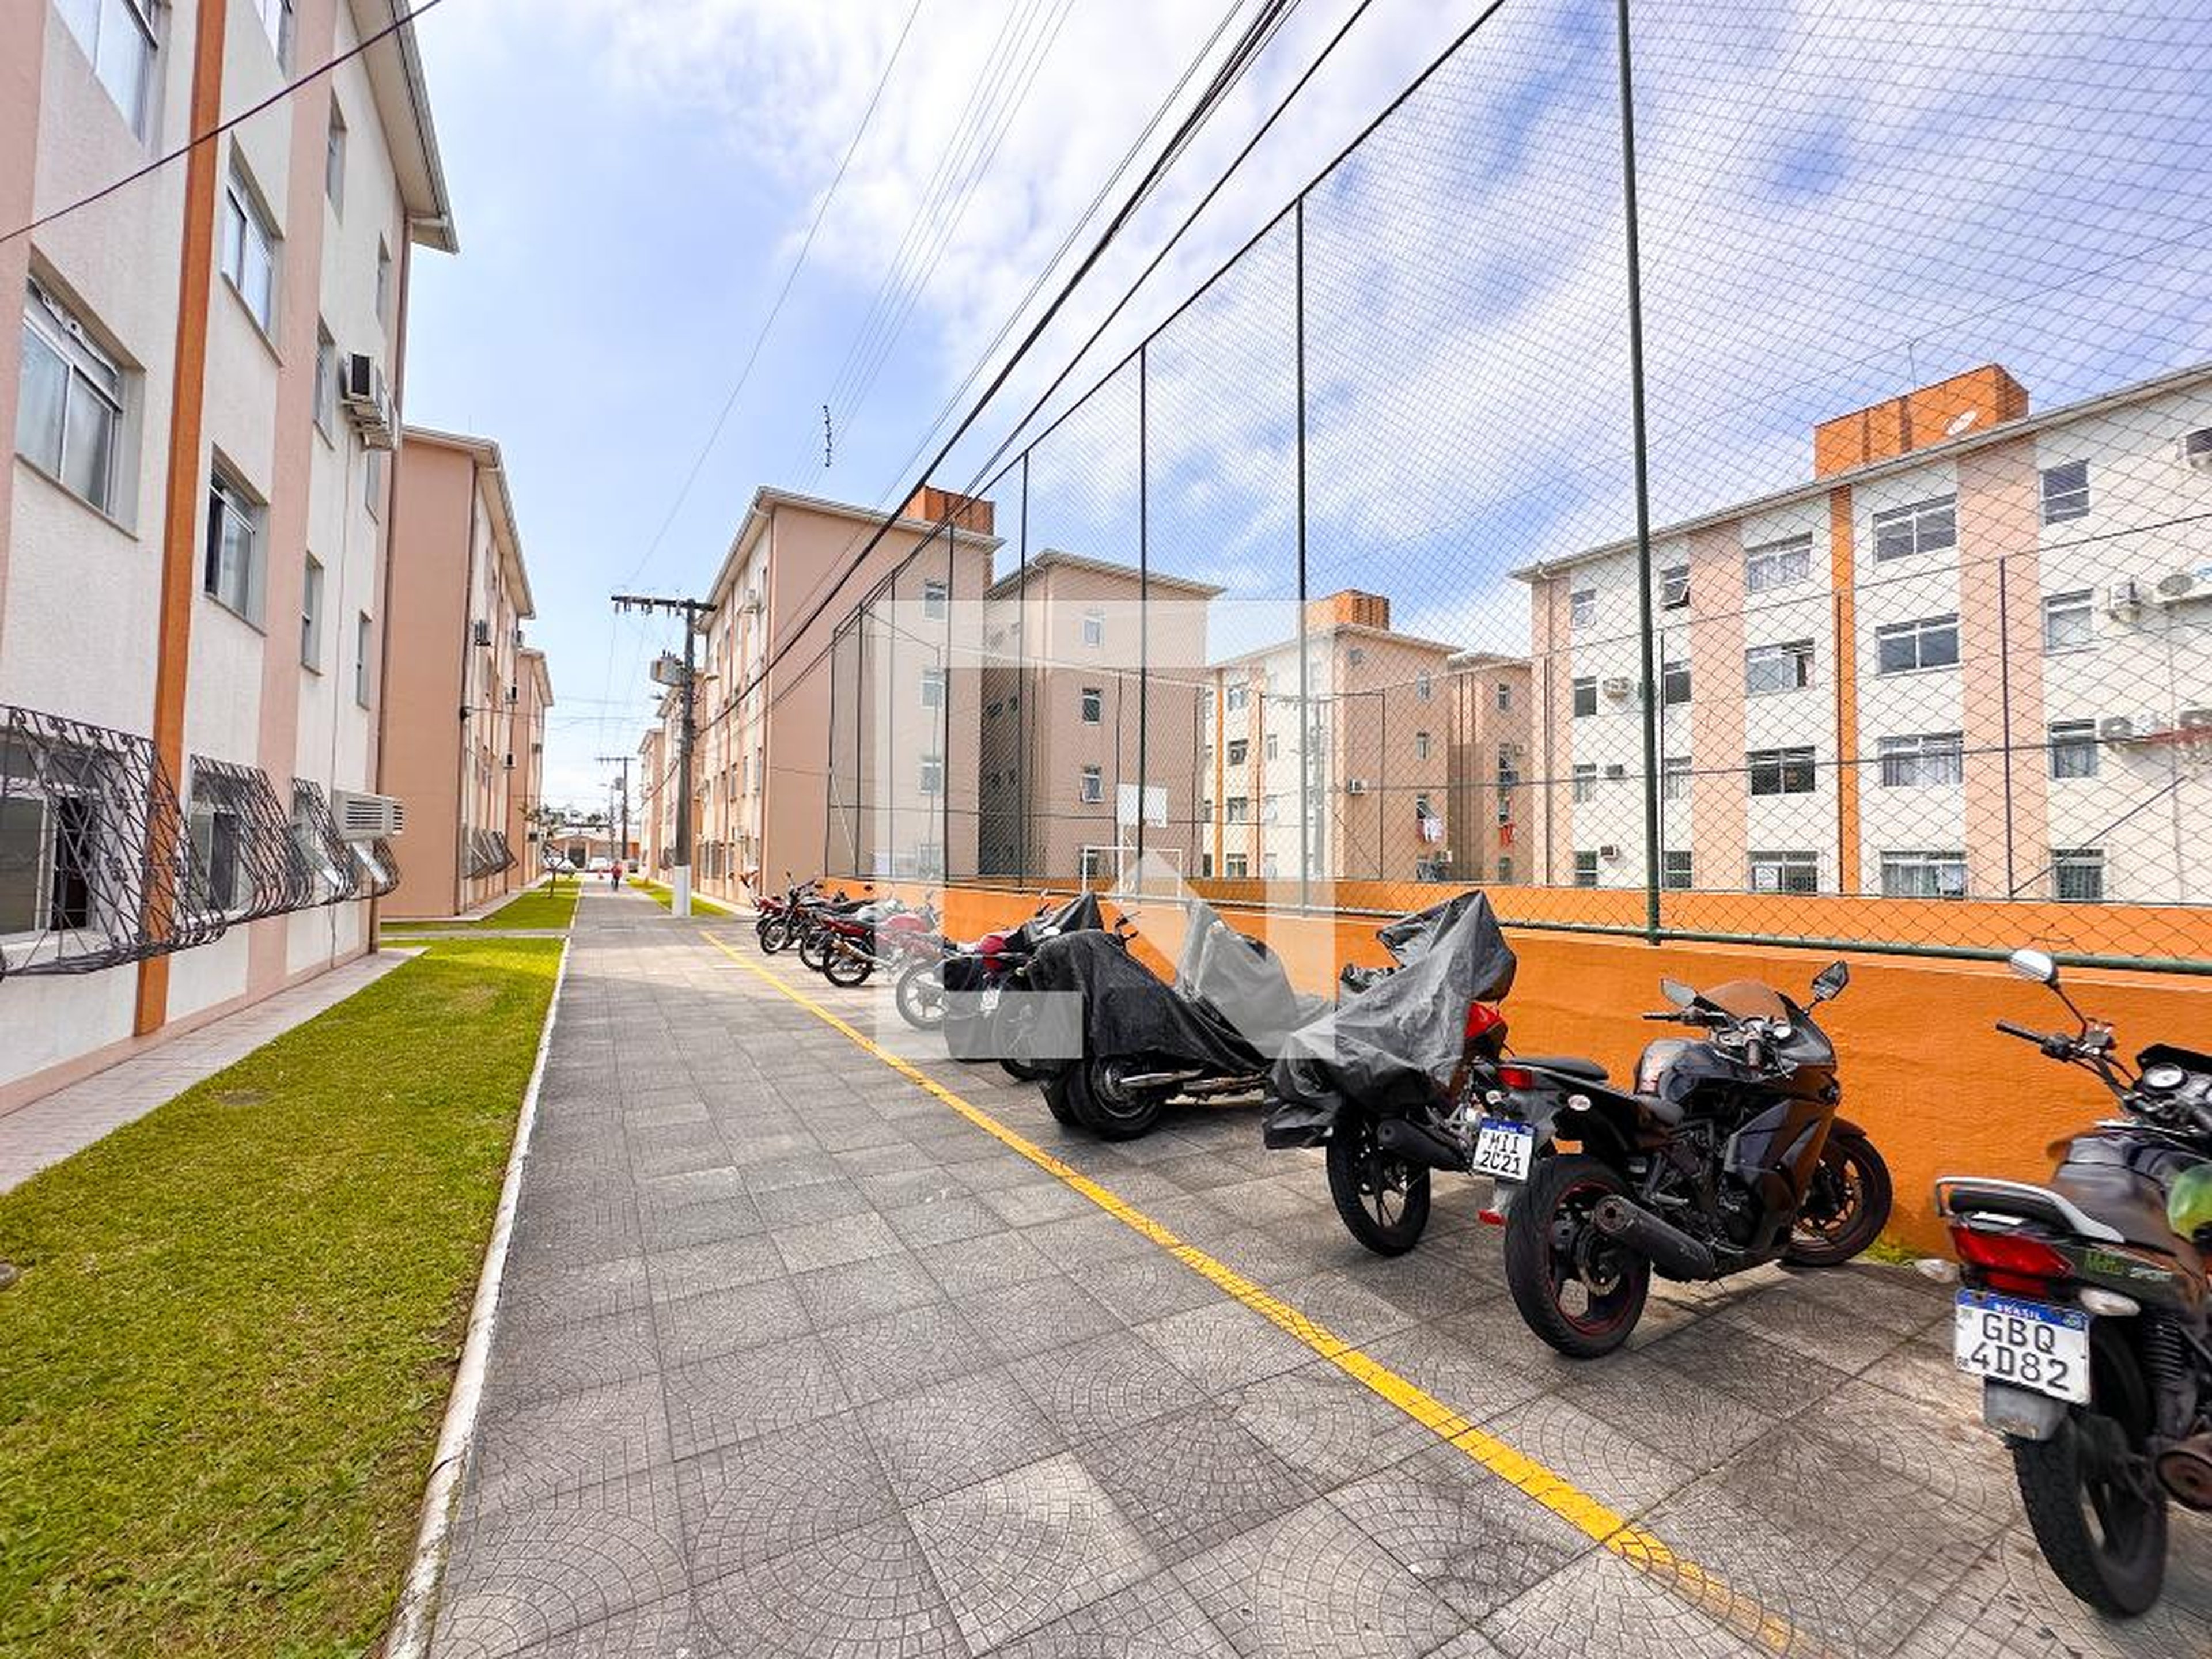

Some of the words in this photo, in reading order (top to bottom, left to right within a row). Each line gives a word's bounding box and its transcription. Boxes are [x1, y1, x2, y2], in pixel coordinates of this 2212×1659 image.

[1993, 1303, 2043, 1321] BRASIL
[1982, 1313, 2055, 1355] GBQ
[1970, 1342, 2070, 1392] 4D82
